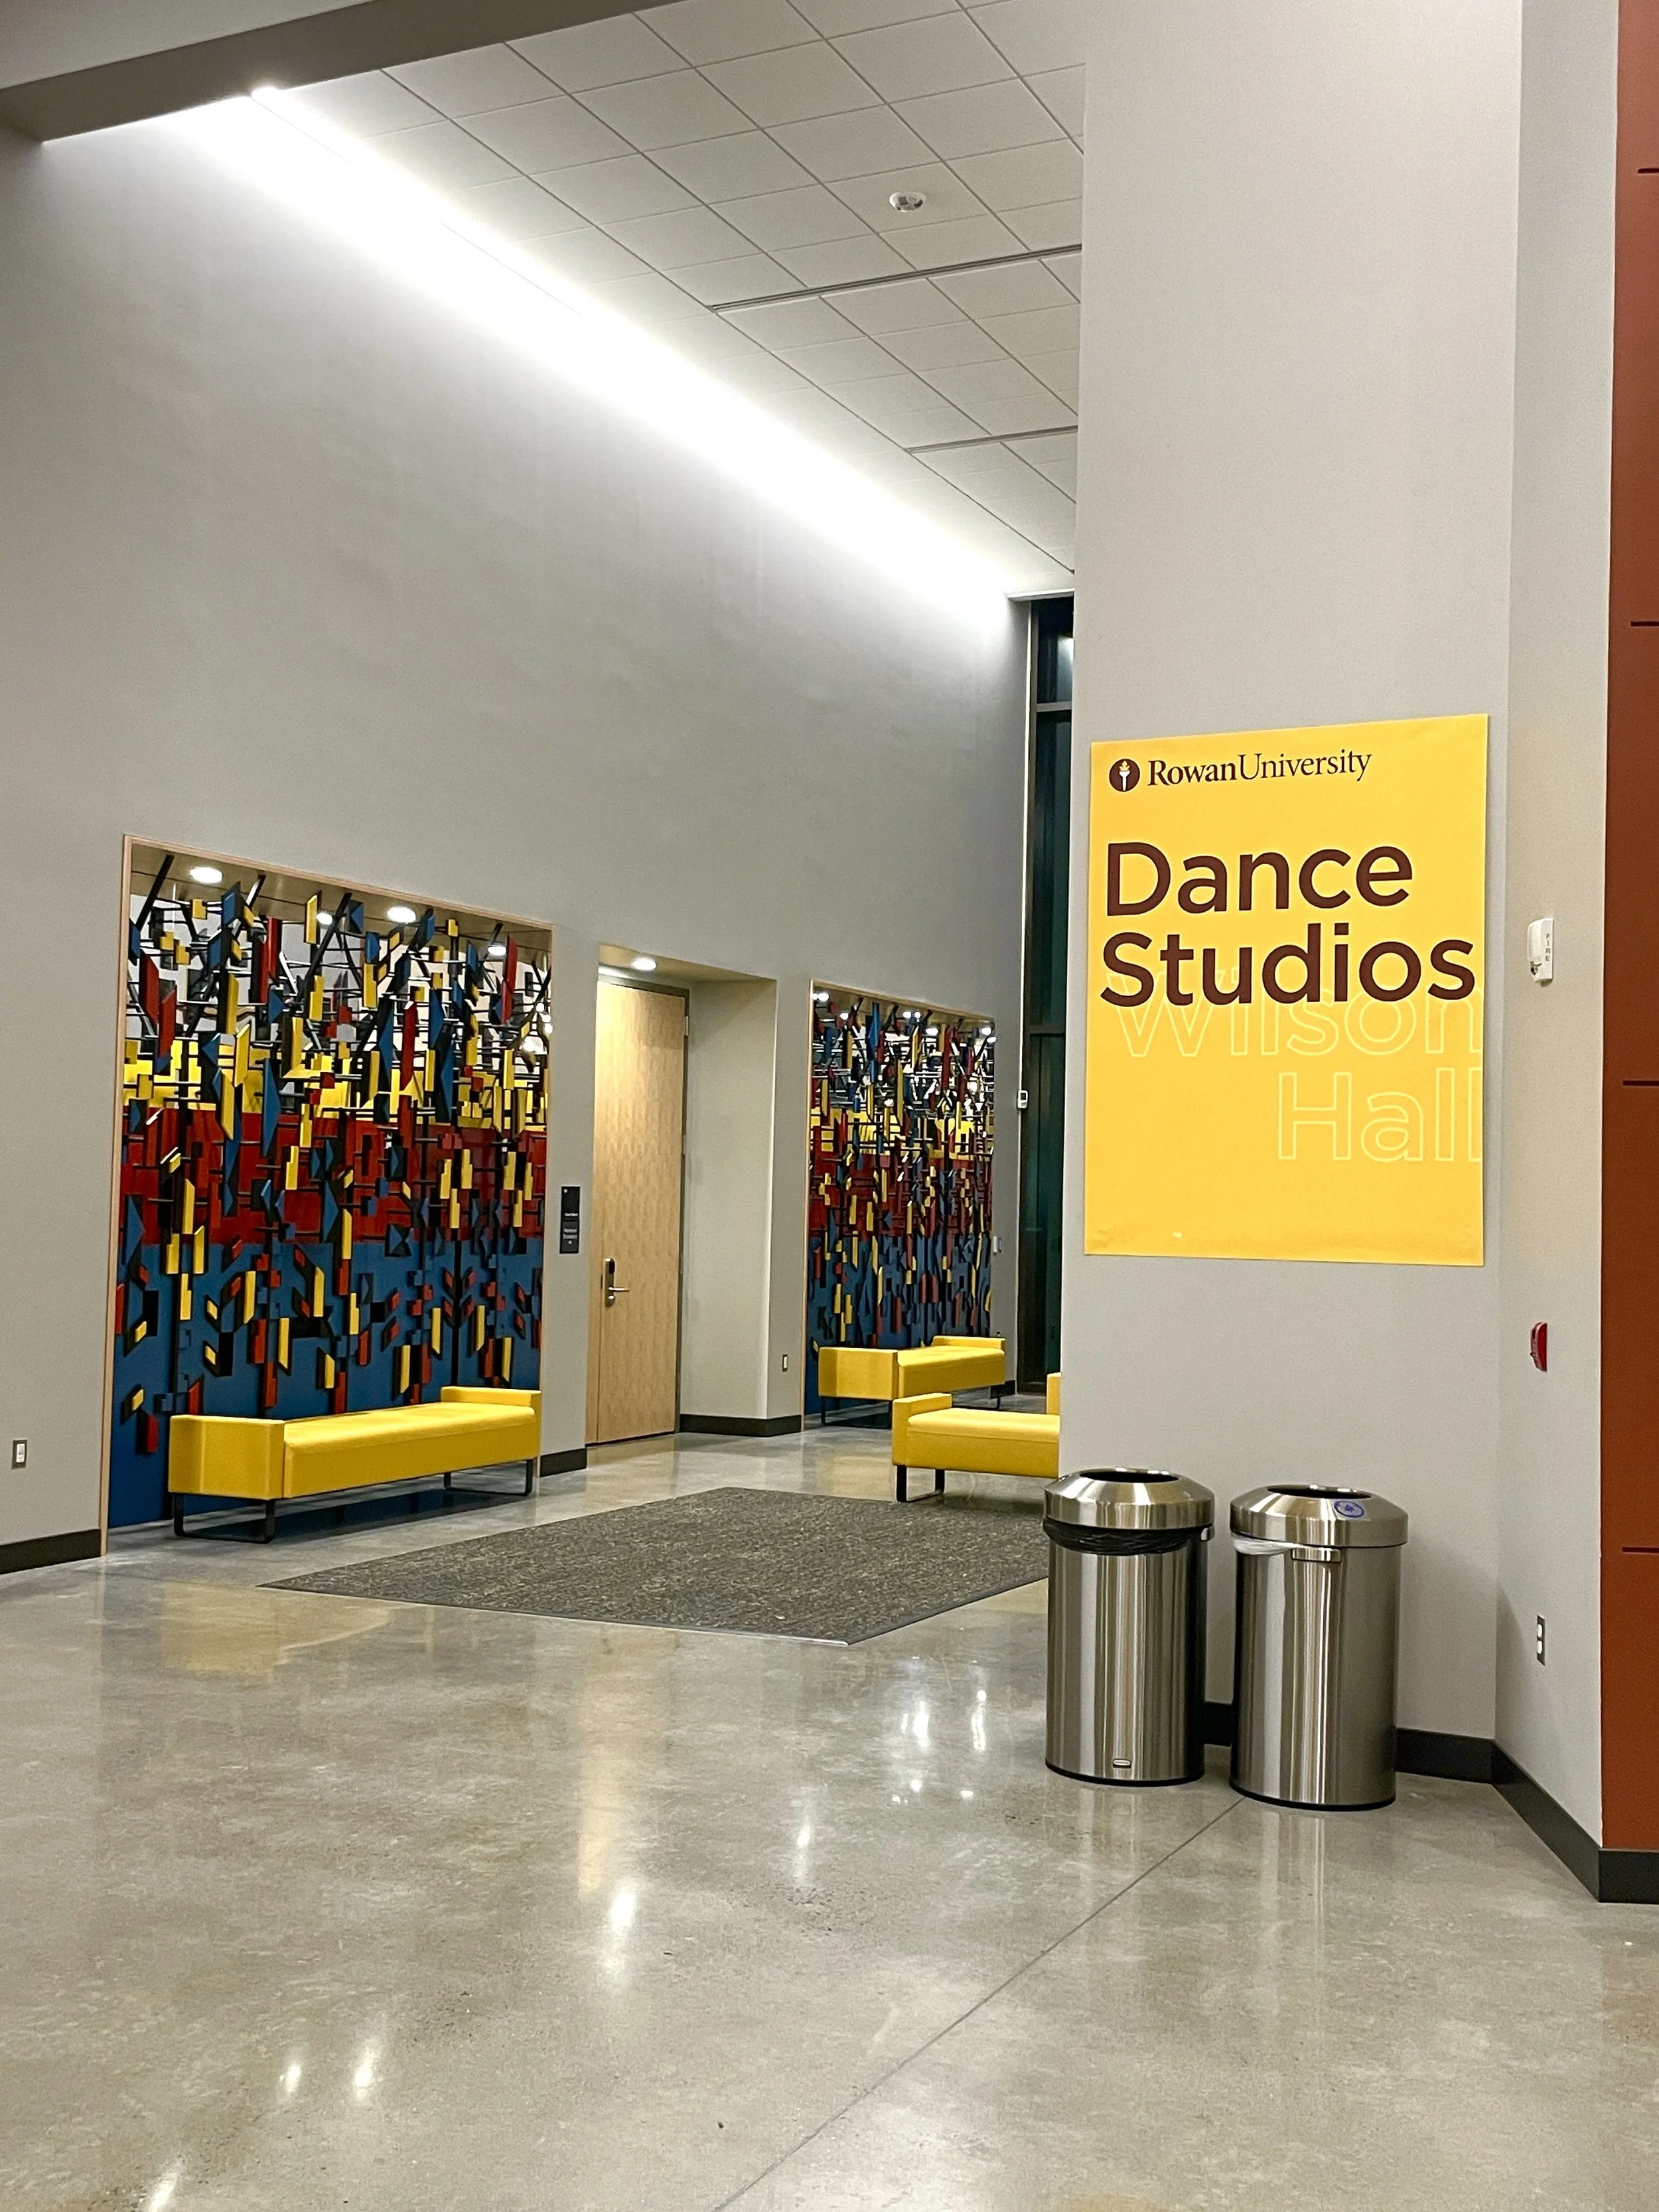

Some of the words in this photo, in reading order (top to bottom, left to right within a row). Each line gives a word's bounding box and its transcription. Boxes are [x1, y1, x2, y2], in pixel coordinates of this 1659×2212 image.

[1107, 842, 1413, 917] Dance
[1100, 922, 1475, 1007] Studios
[1106, 966, 1482, 1057] Wilson
[1278, 1067, 1482, 1163] Hall
